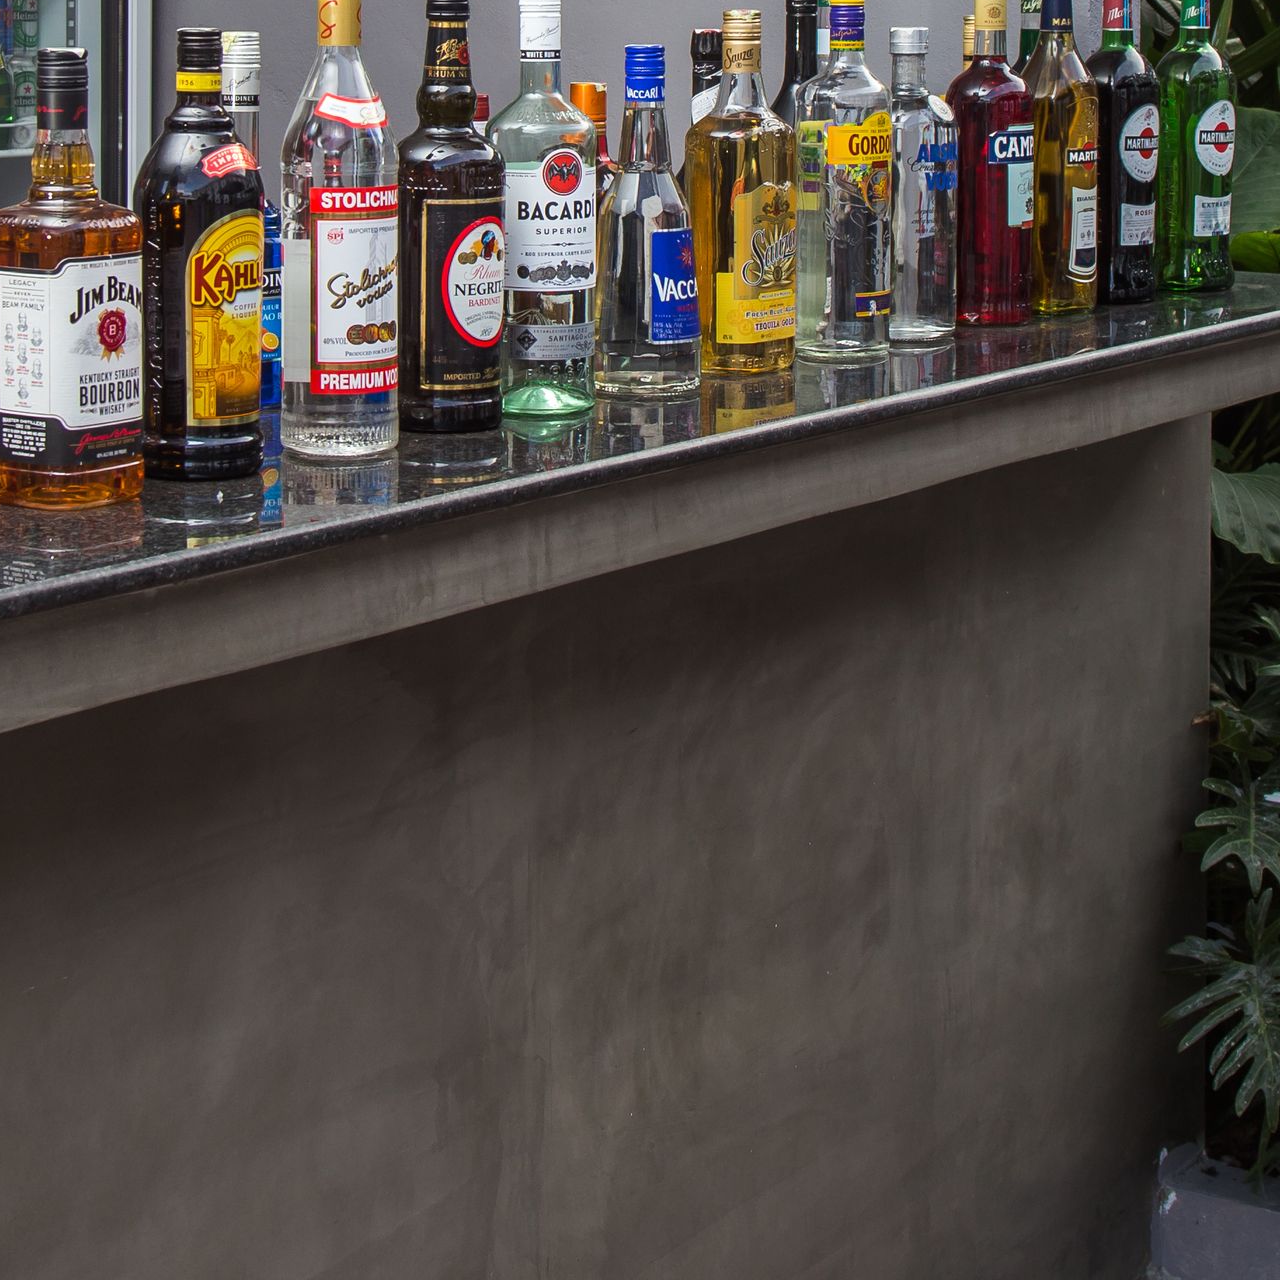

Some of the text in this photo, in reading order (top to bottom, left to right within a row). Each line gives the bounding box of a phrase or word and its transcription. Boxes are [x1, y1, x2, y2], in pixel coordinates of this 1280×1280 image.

[724, 48, 754, 69] Sauza
[428, 70, 456, 78] RHUM
[626, 86, 658, 99] VACCARI
[536, 227, 587, 235] SUPERIOR
[8, 279, 37, 287] LEGACY
[2, 300, 45, 312] BEAM FAMILY
[69, 284, 105, 325] JIM
[234, 303, 257, 311] COFFEE
[745, 311, 768, 319] FRESH
[109, 324, 117, 335] B
[754, 321, 780, 331] TEQUILA
[79, 366, 139, 385] KENTUCKY STRAIGHT
[320, 371, 384, 390] PREMIUM
[443, 372, 481, 380] IMPORTED
[79, 378, 140, 407] BOURBON
[99, 403, 125, 416] WHISKEY
